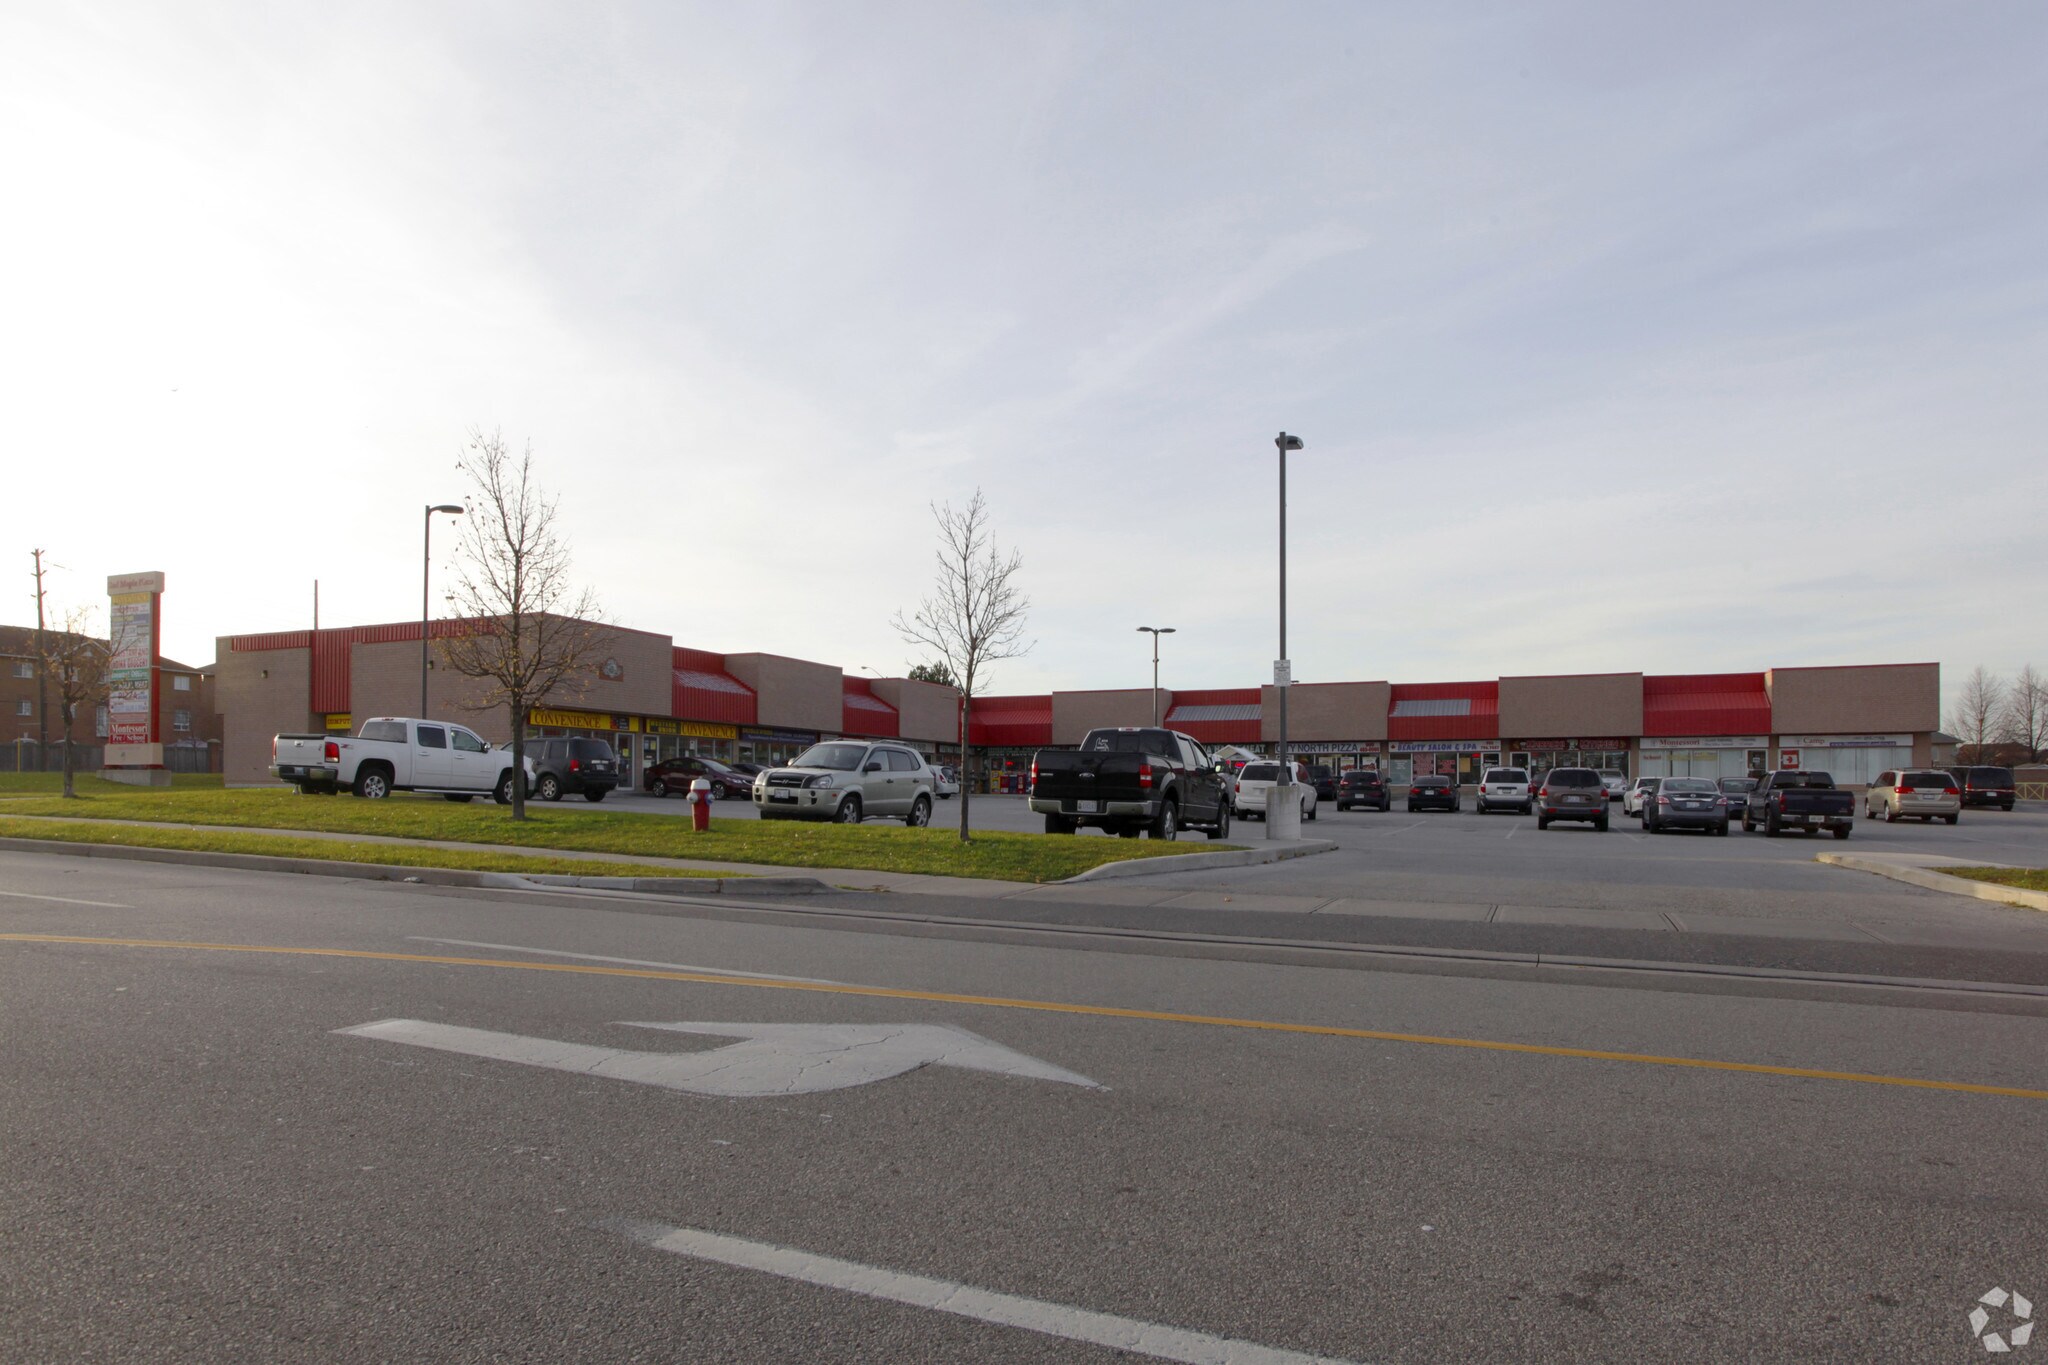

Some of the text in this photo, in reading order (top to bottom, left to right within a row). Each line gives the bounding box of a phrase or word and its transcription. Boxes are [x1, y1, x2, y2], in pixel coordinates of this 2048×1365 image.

[535, 712, 600, 728] CONVENIENCE
[112, 724, 148, 734] Montessori
[682, 721, 735, 738] CONVENIENCE
[1659, 738, 1700, 747] Montessori
[1803, 736, 1825, 745] Camp
[1276, 744, 1295, 753] CTY
[1298, 743, 1329, 753] NORTH
[1331, 743, 1358, 752] PIZZA
[1398, 744, 1425, 752] BEAUTY
[1463, 743, 1478, 751] SPA
